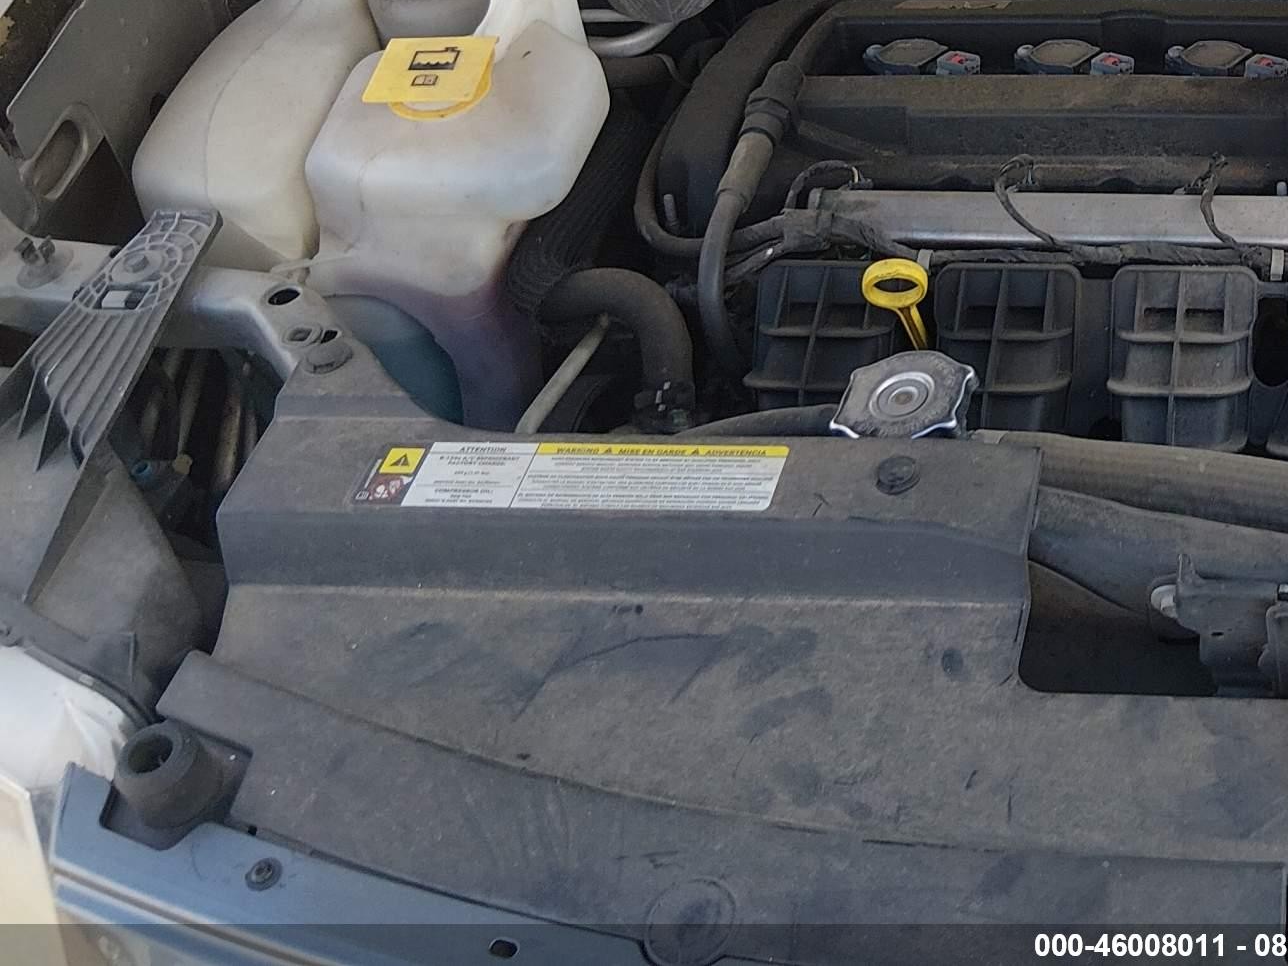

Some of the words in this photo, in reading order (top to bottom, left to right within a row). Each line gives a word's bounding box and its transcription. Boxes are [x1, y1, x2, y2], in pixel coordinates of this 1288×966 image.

[556, 447, 599, 455] WARNING
[641, 448, 656, 456] EN
[657, 448, 686, 456] GARDE
